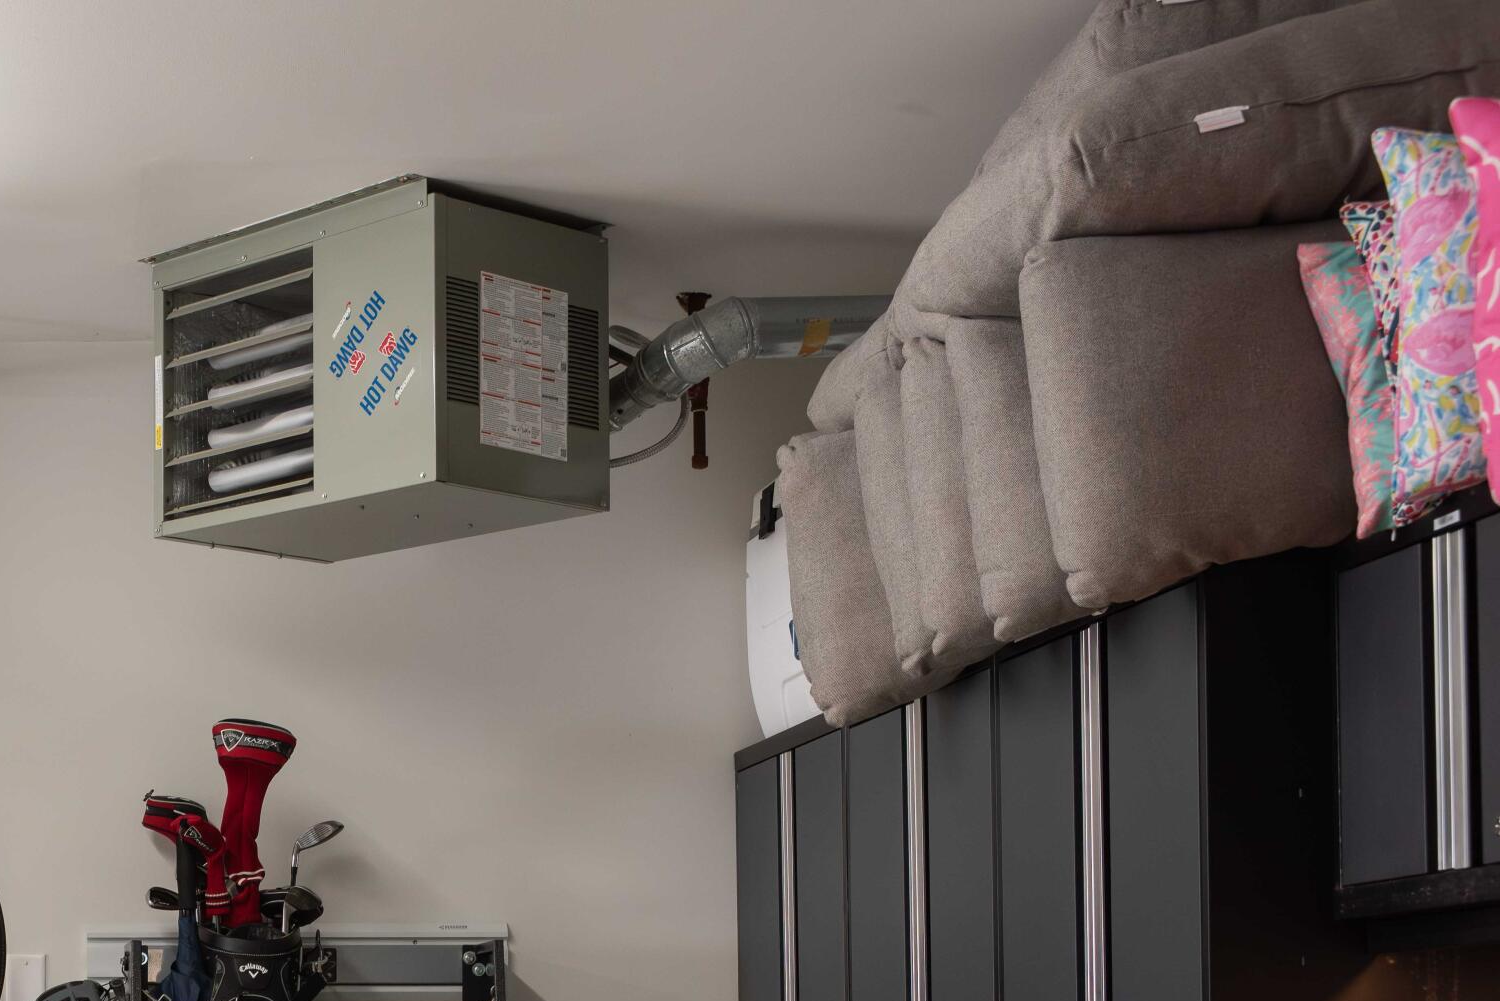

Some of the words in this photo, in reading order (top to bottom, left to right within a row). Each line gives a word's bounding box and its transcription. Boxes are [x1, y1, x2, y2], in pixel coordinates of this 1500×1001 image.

[359, 290, 386, 331] HOT
[328, 325, 365, 378] DAWG
[359, 376, 387, 416] HOT
[380, 327, 418, 382] DAWG
